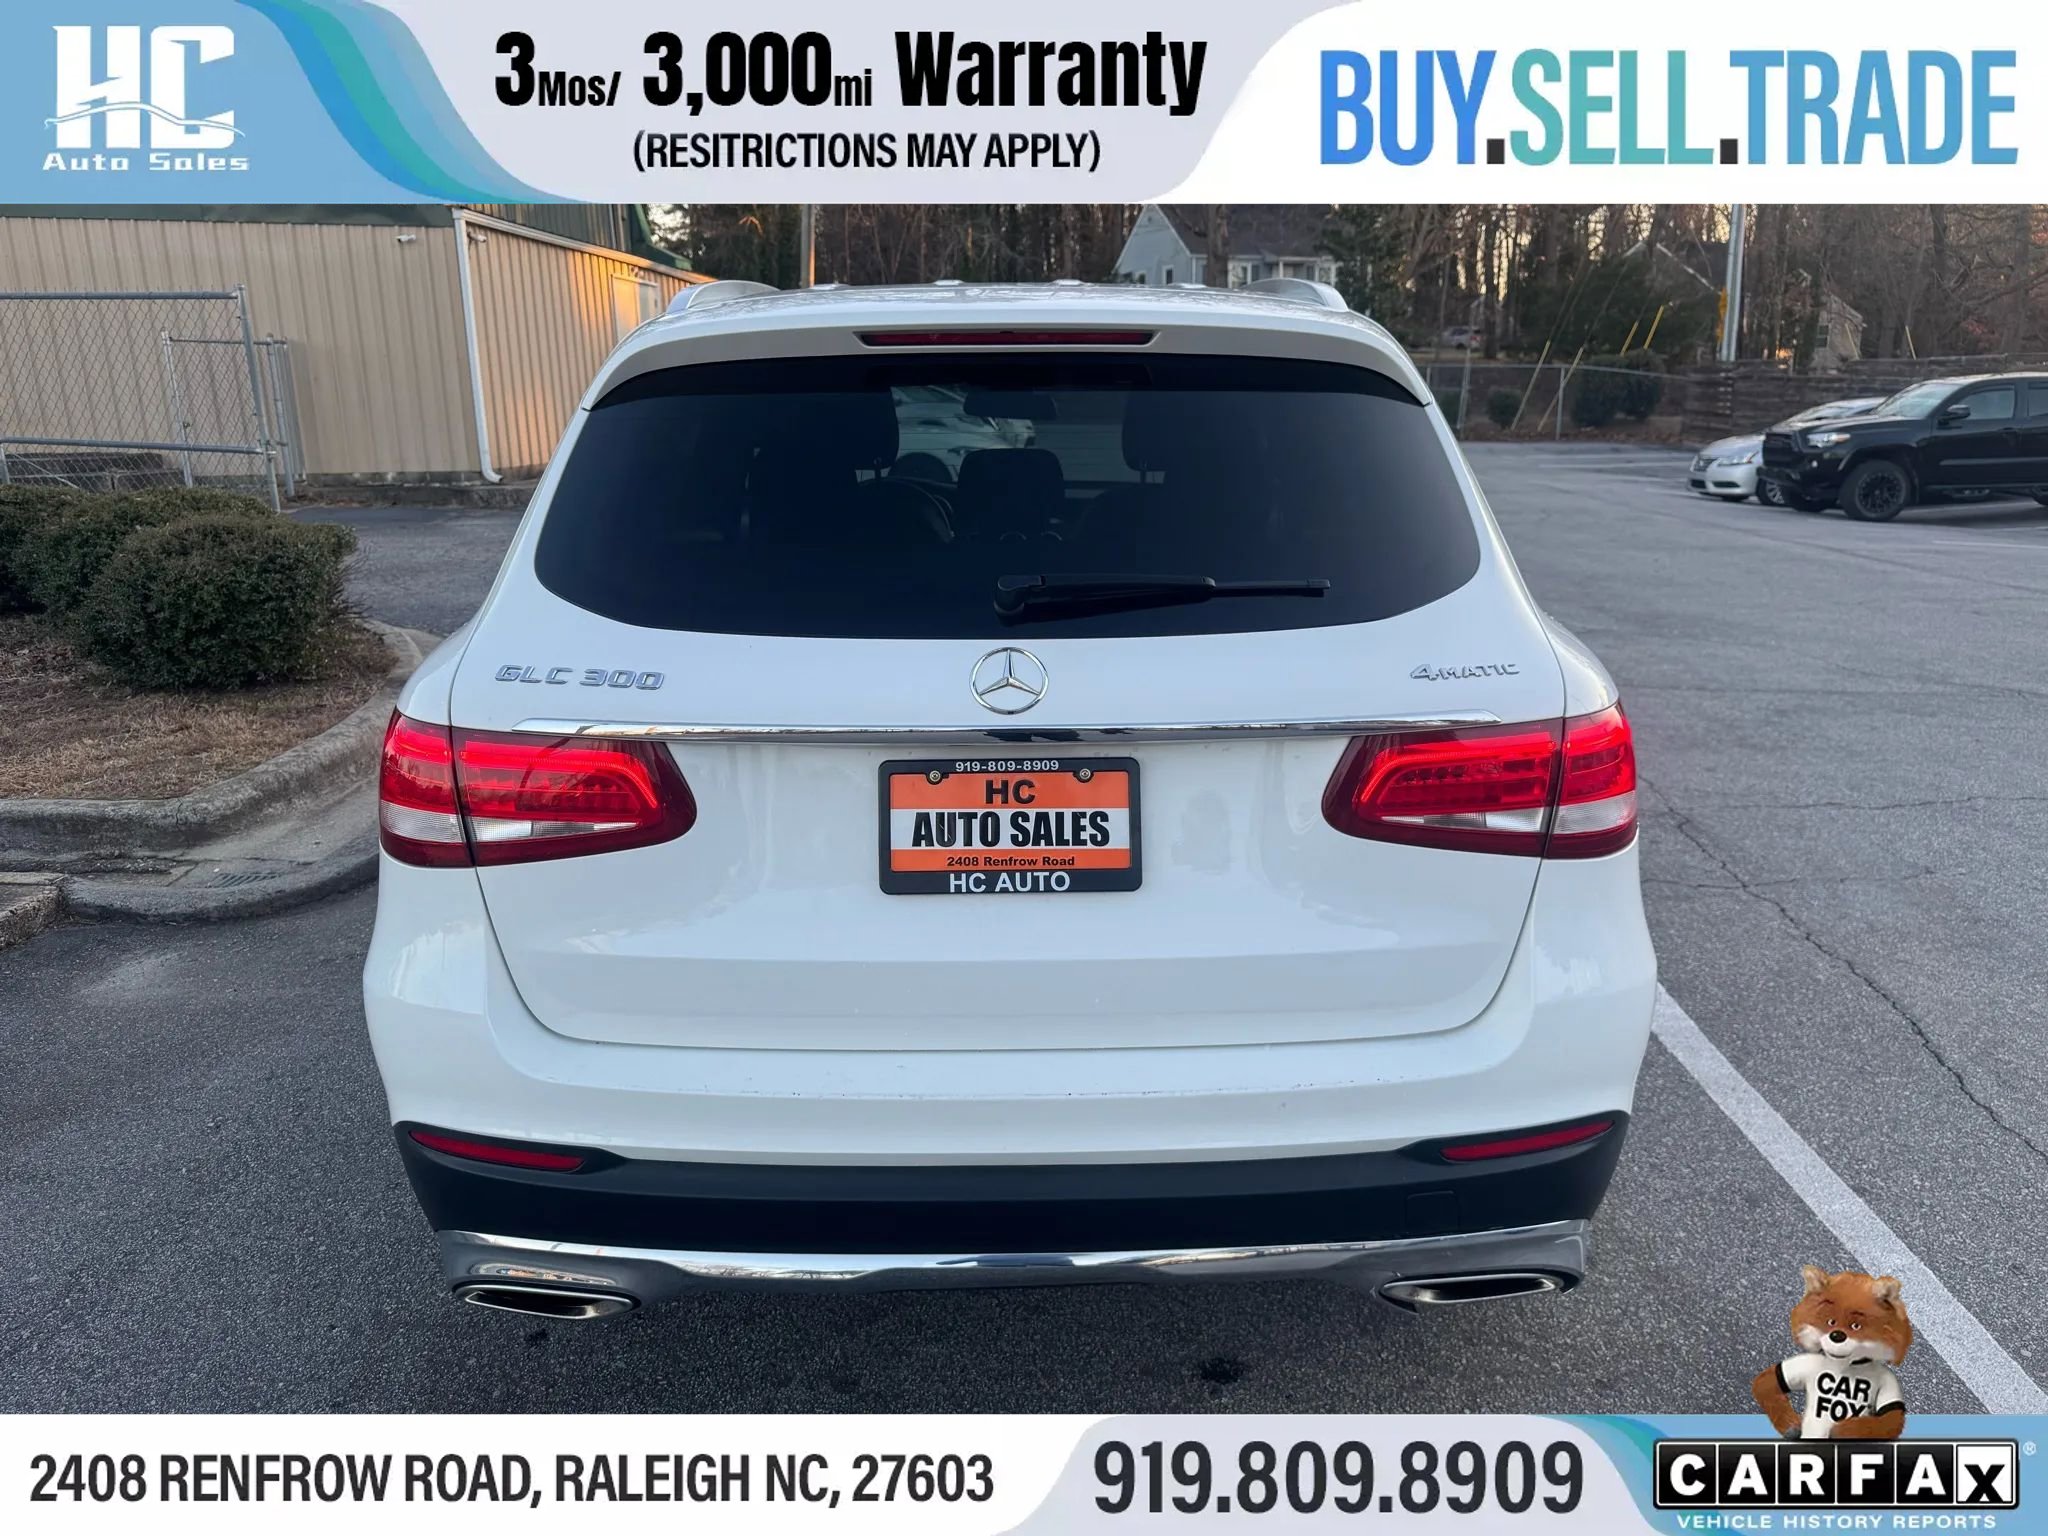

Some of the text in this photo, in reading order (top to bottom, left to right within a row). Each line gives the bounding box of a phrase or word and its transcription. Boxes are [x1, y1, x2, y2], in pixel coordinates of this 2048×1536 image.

[495, 664, 665, 690] GLC 300
[1410, 664, 1520, 681] 4MATIC
[955, 760, 1059, 772] 919-809-8909
[985, 779, 1036, 805] HC
[912, 811, 1110, 847] AUTO SALES
[947, 856, 1075, 867] 2408 Renfrow Road
[950, 871, 1071, 893] HC AUTO
